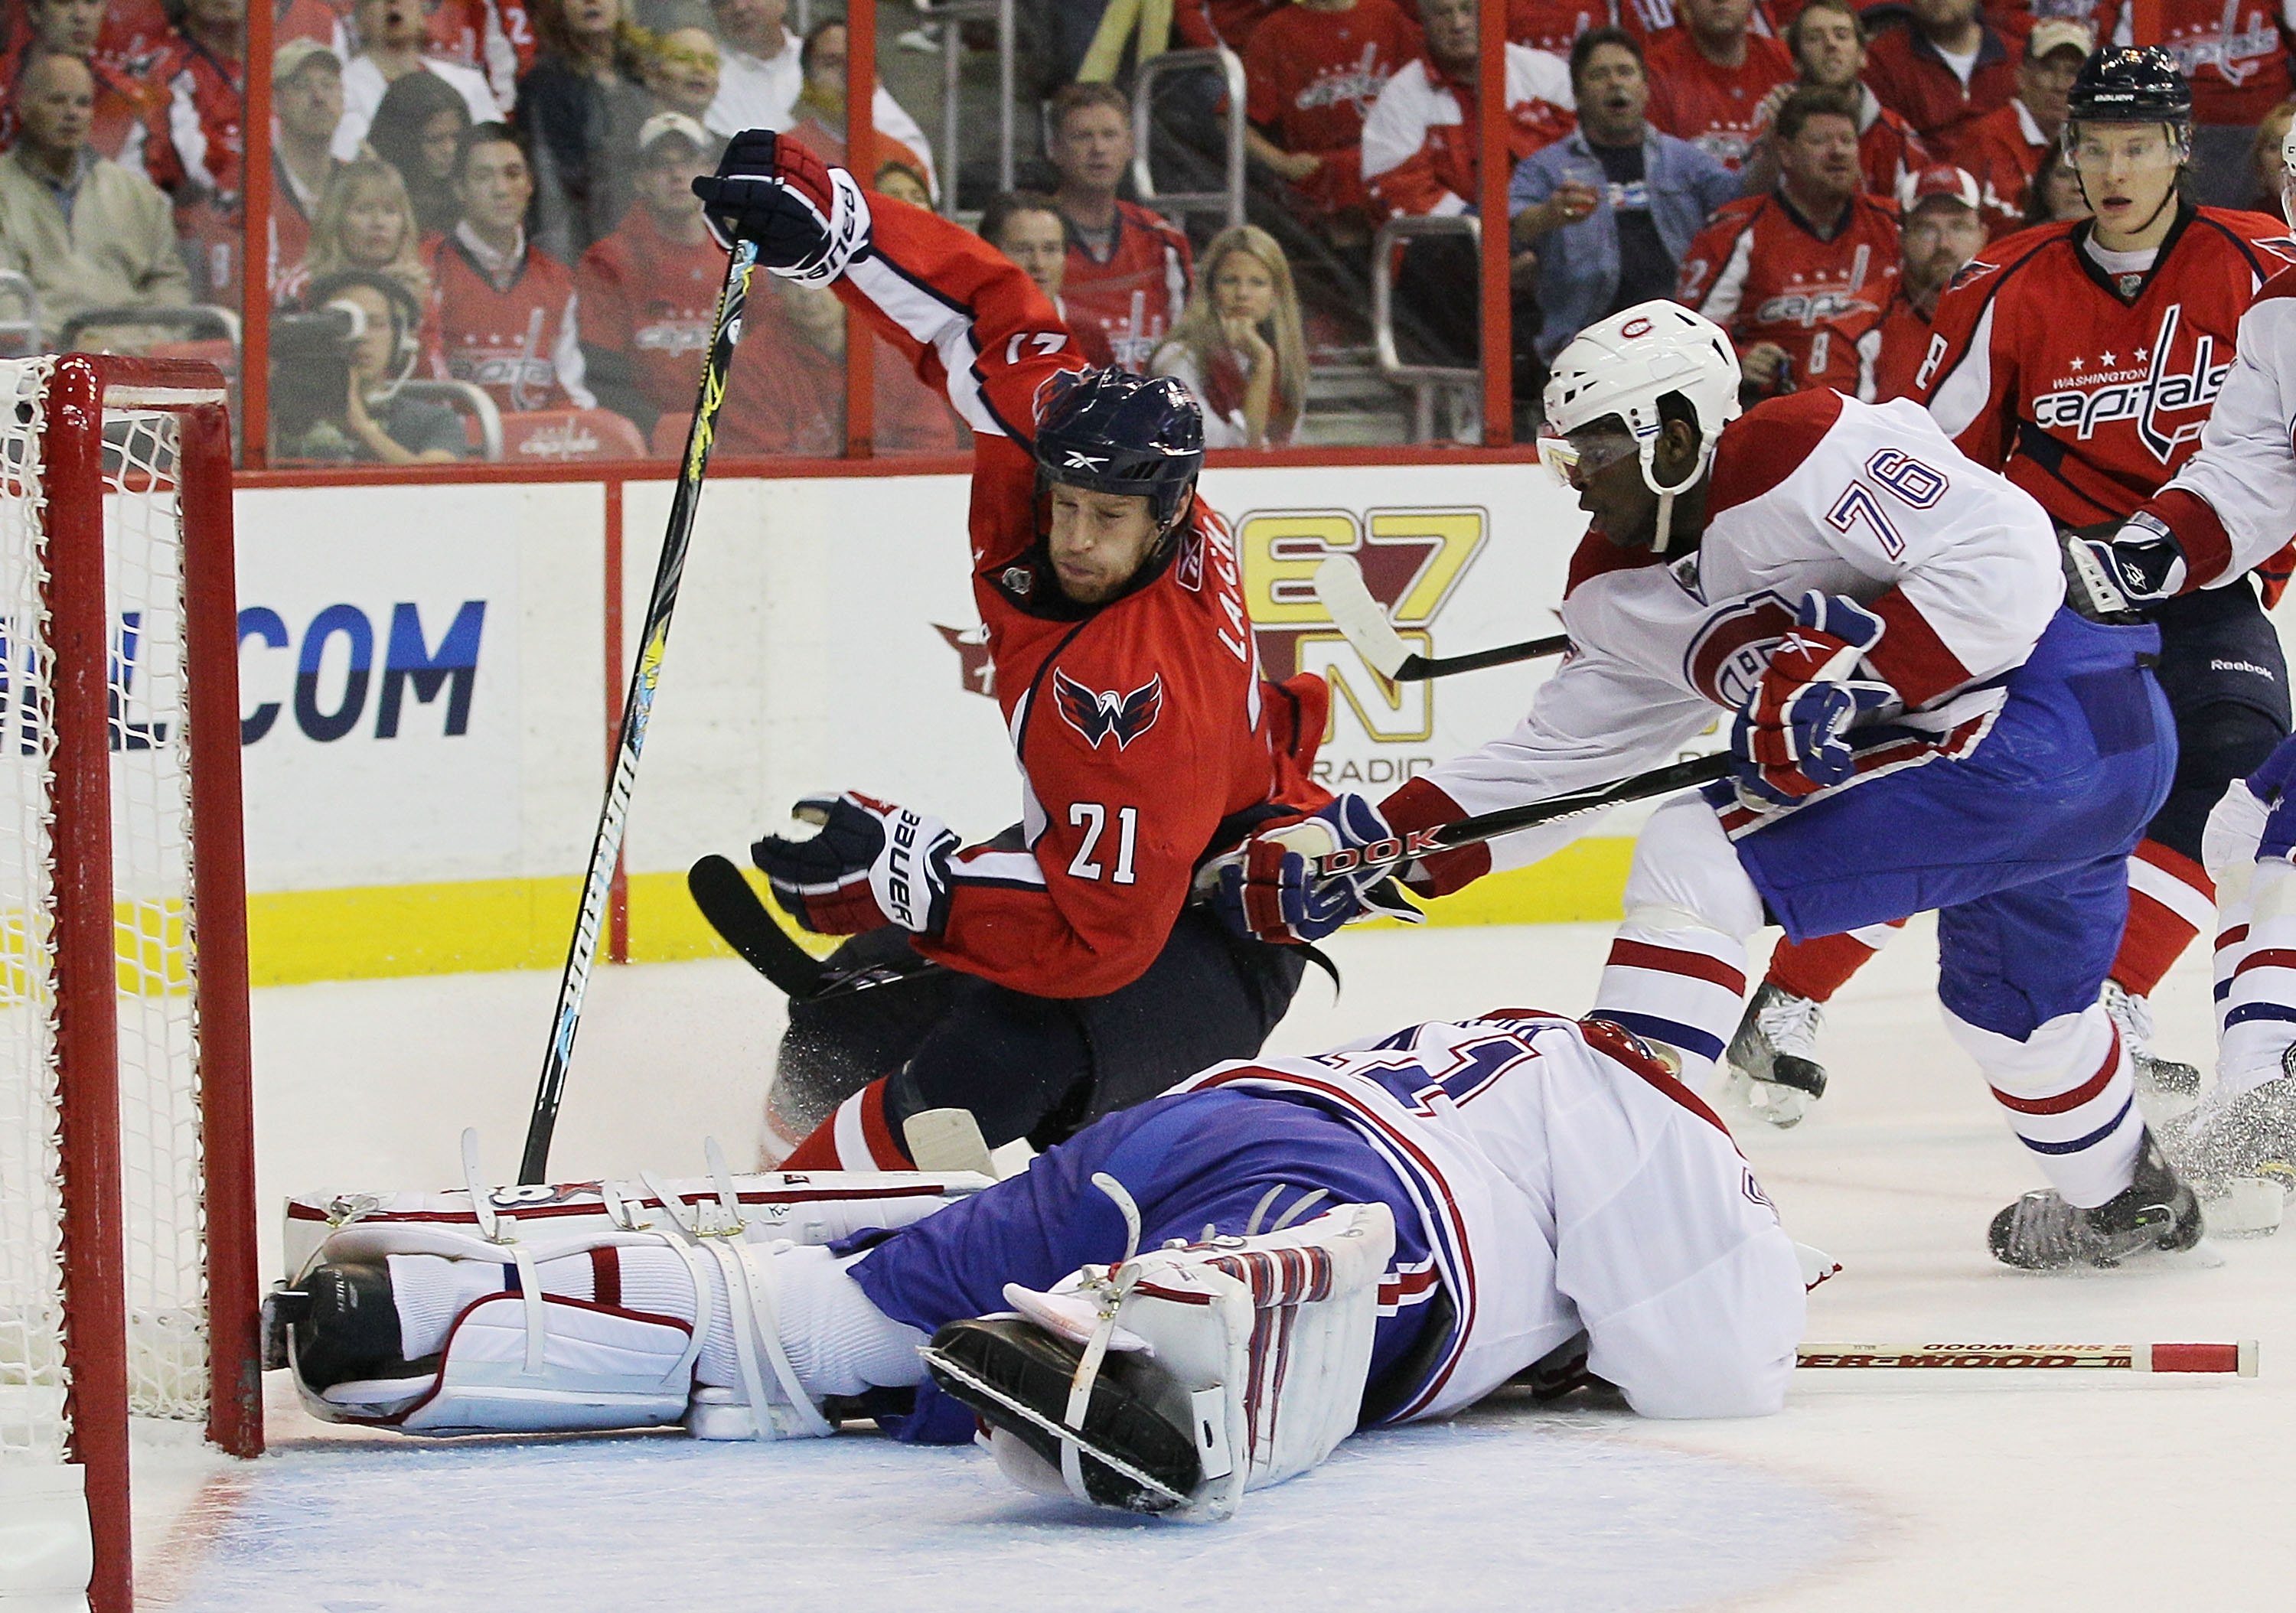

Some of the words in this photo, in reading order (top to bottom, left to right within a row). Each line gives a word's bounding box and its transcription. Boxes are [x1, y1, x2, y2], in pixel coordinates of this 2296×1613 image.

[2052, 366, 2149, 413] WASHINGTON
[1824, 448, 1949, 562] 76
[2210, 659, 2275, 682] Reebok
[1067, 802, 1140, 885] 21
[1795, 1354, 2077, 1369] ER-WOOD
